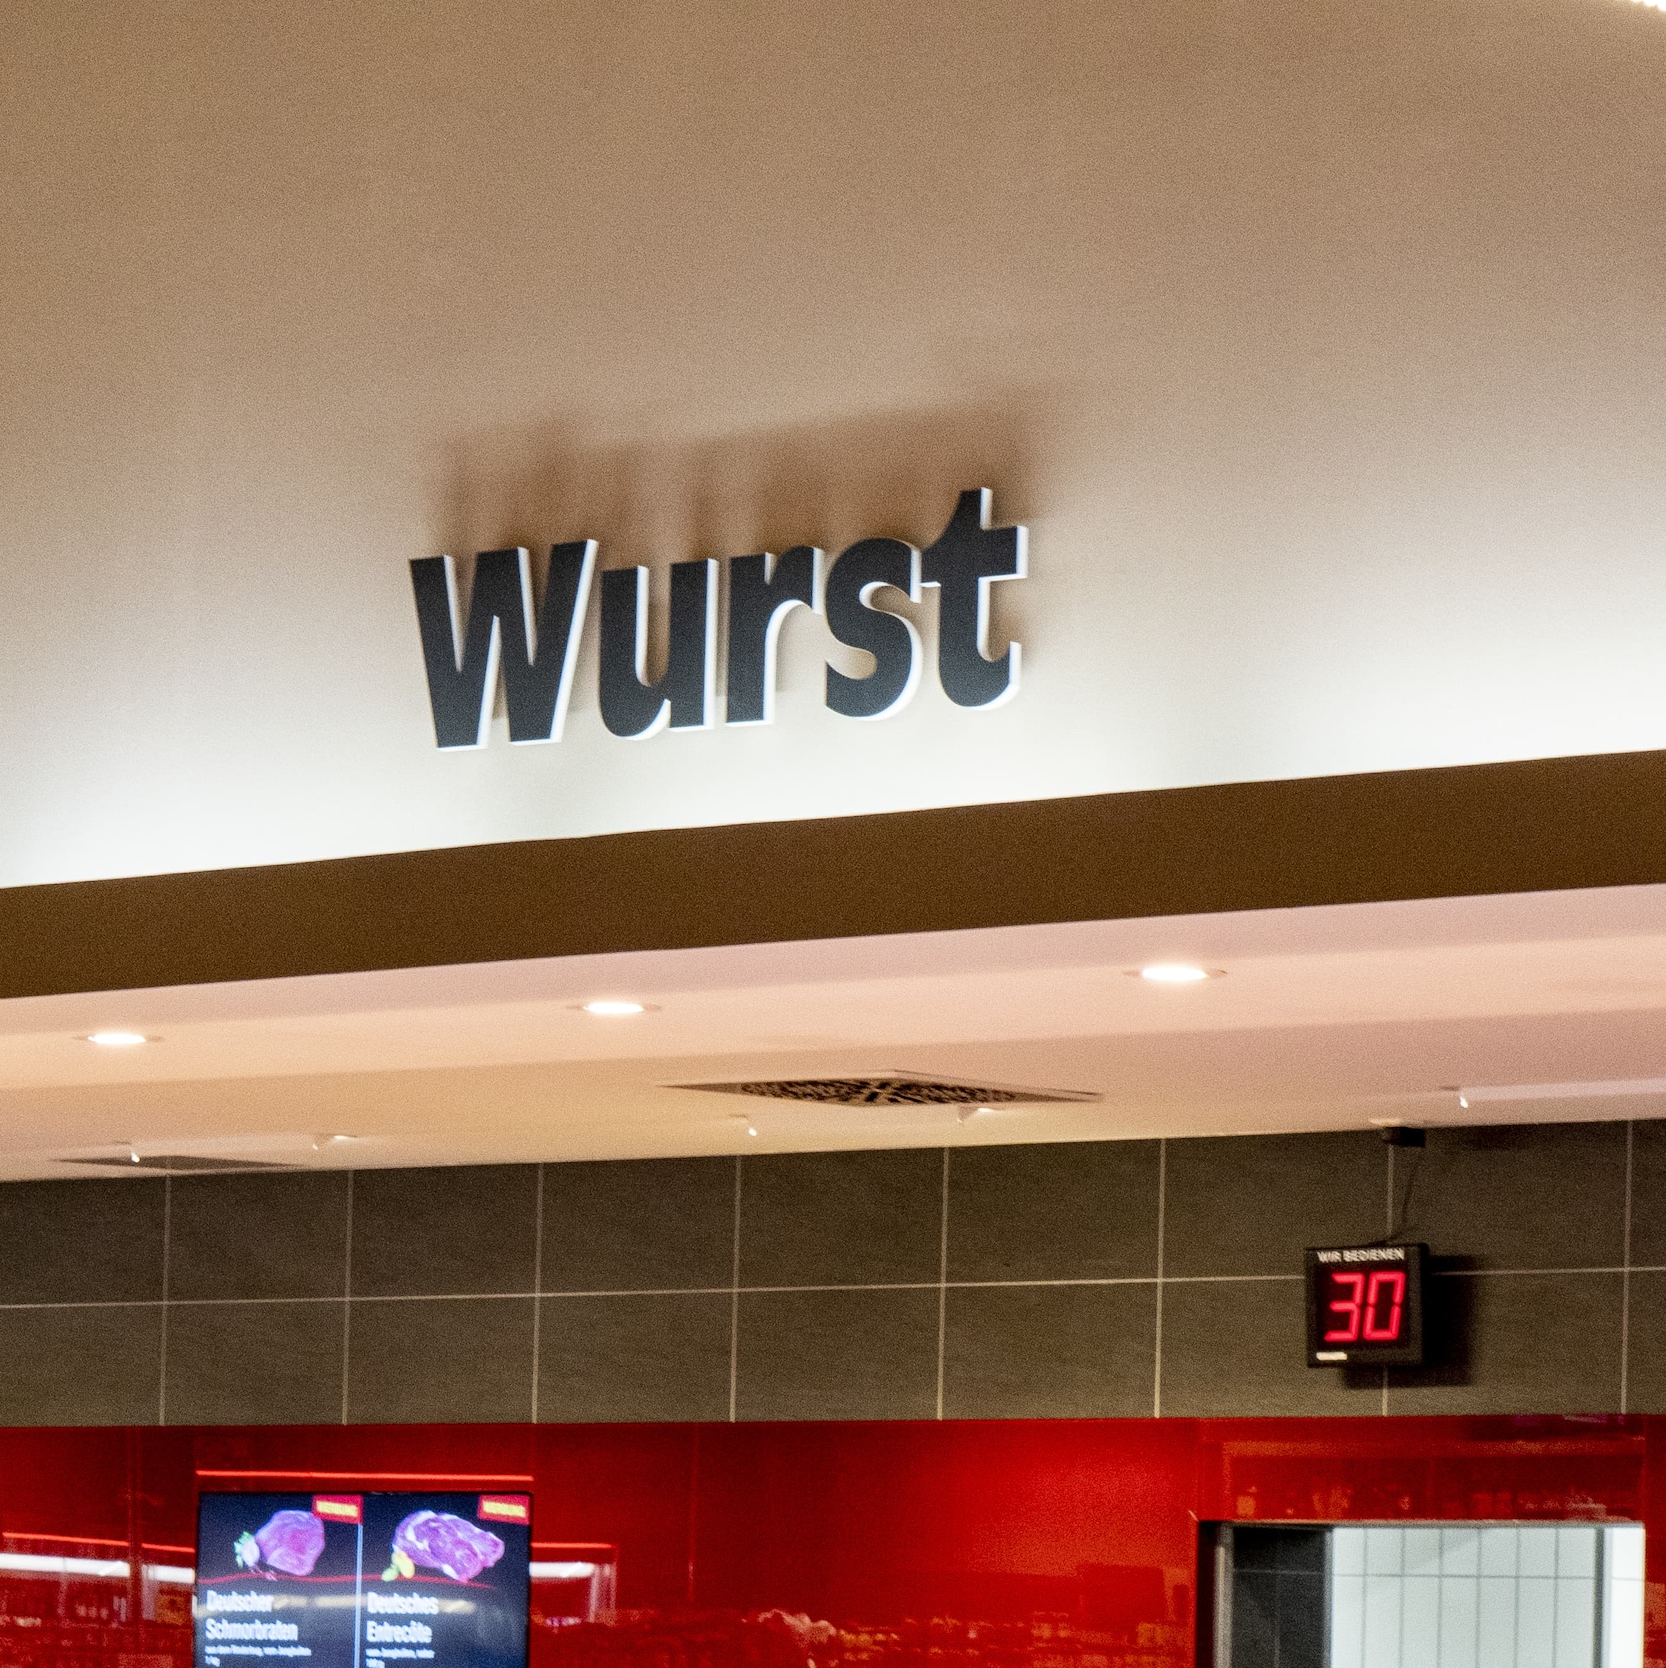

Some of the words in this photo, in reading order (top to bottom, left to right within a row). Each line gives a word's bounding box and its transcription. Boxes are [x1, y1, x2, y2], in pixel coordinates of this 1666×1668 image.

[409, 487, 1029, 751] Wurst
[1317, 1250, 1342, 1263] WIR
[1343, 1248, 1405, 1262] BEDIENEN
[1323, 1271, 1406, 1342] 30
[206, 1590, 274, 1613] Deutscher
[367, 1592, 439, 1616] Deutsches
[205, 1619, 299, 1642] Schmorbraten
[366, 1620, 433, 1644] Entrecôte
